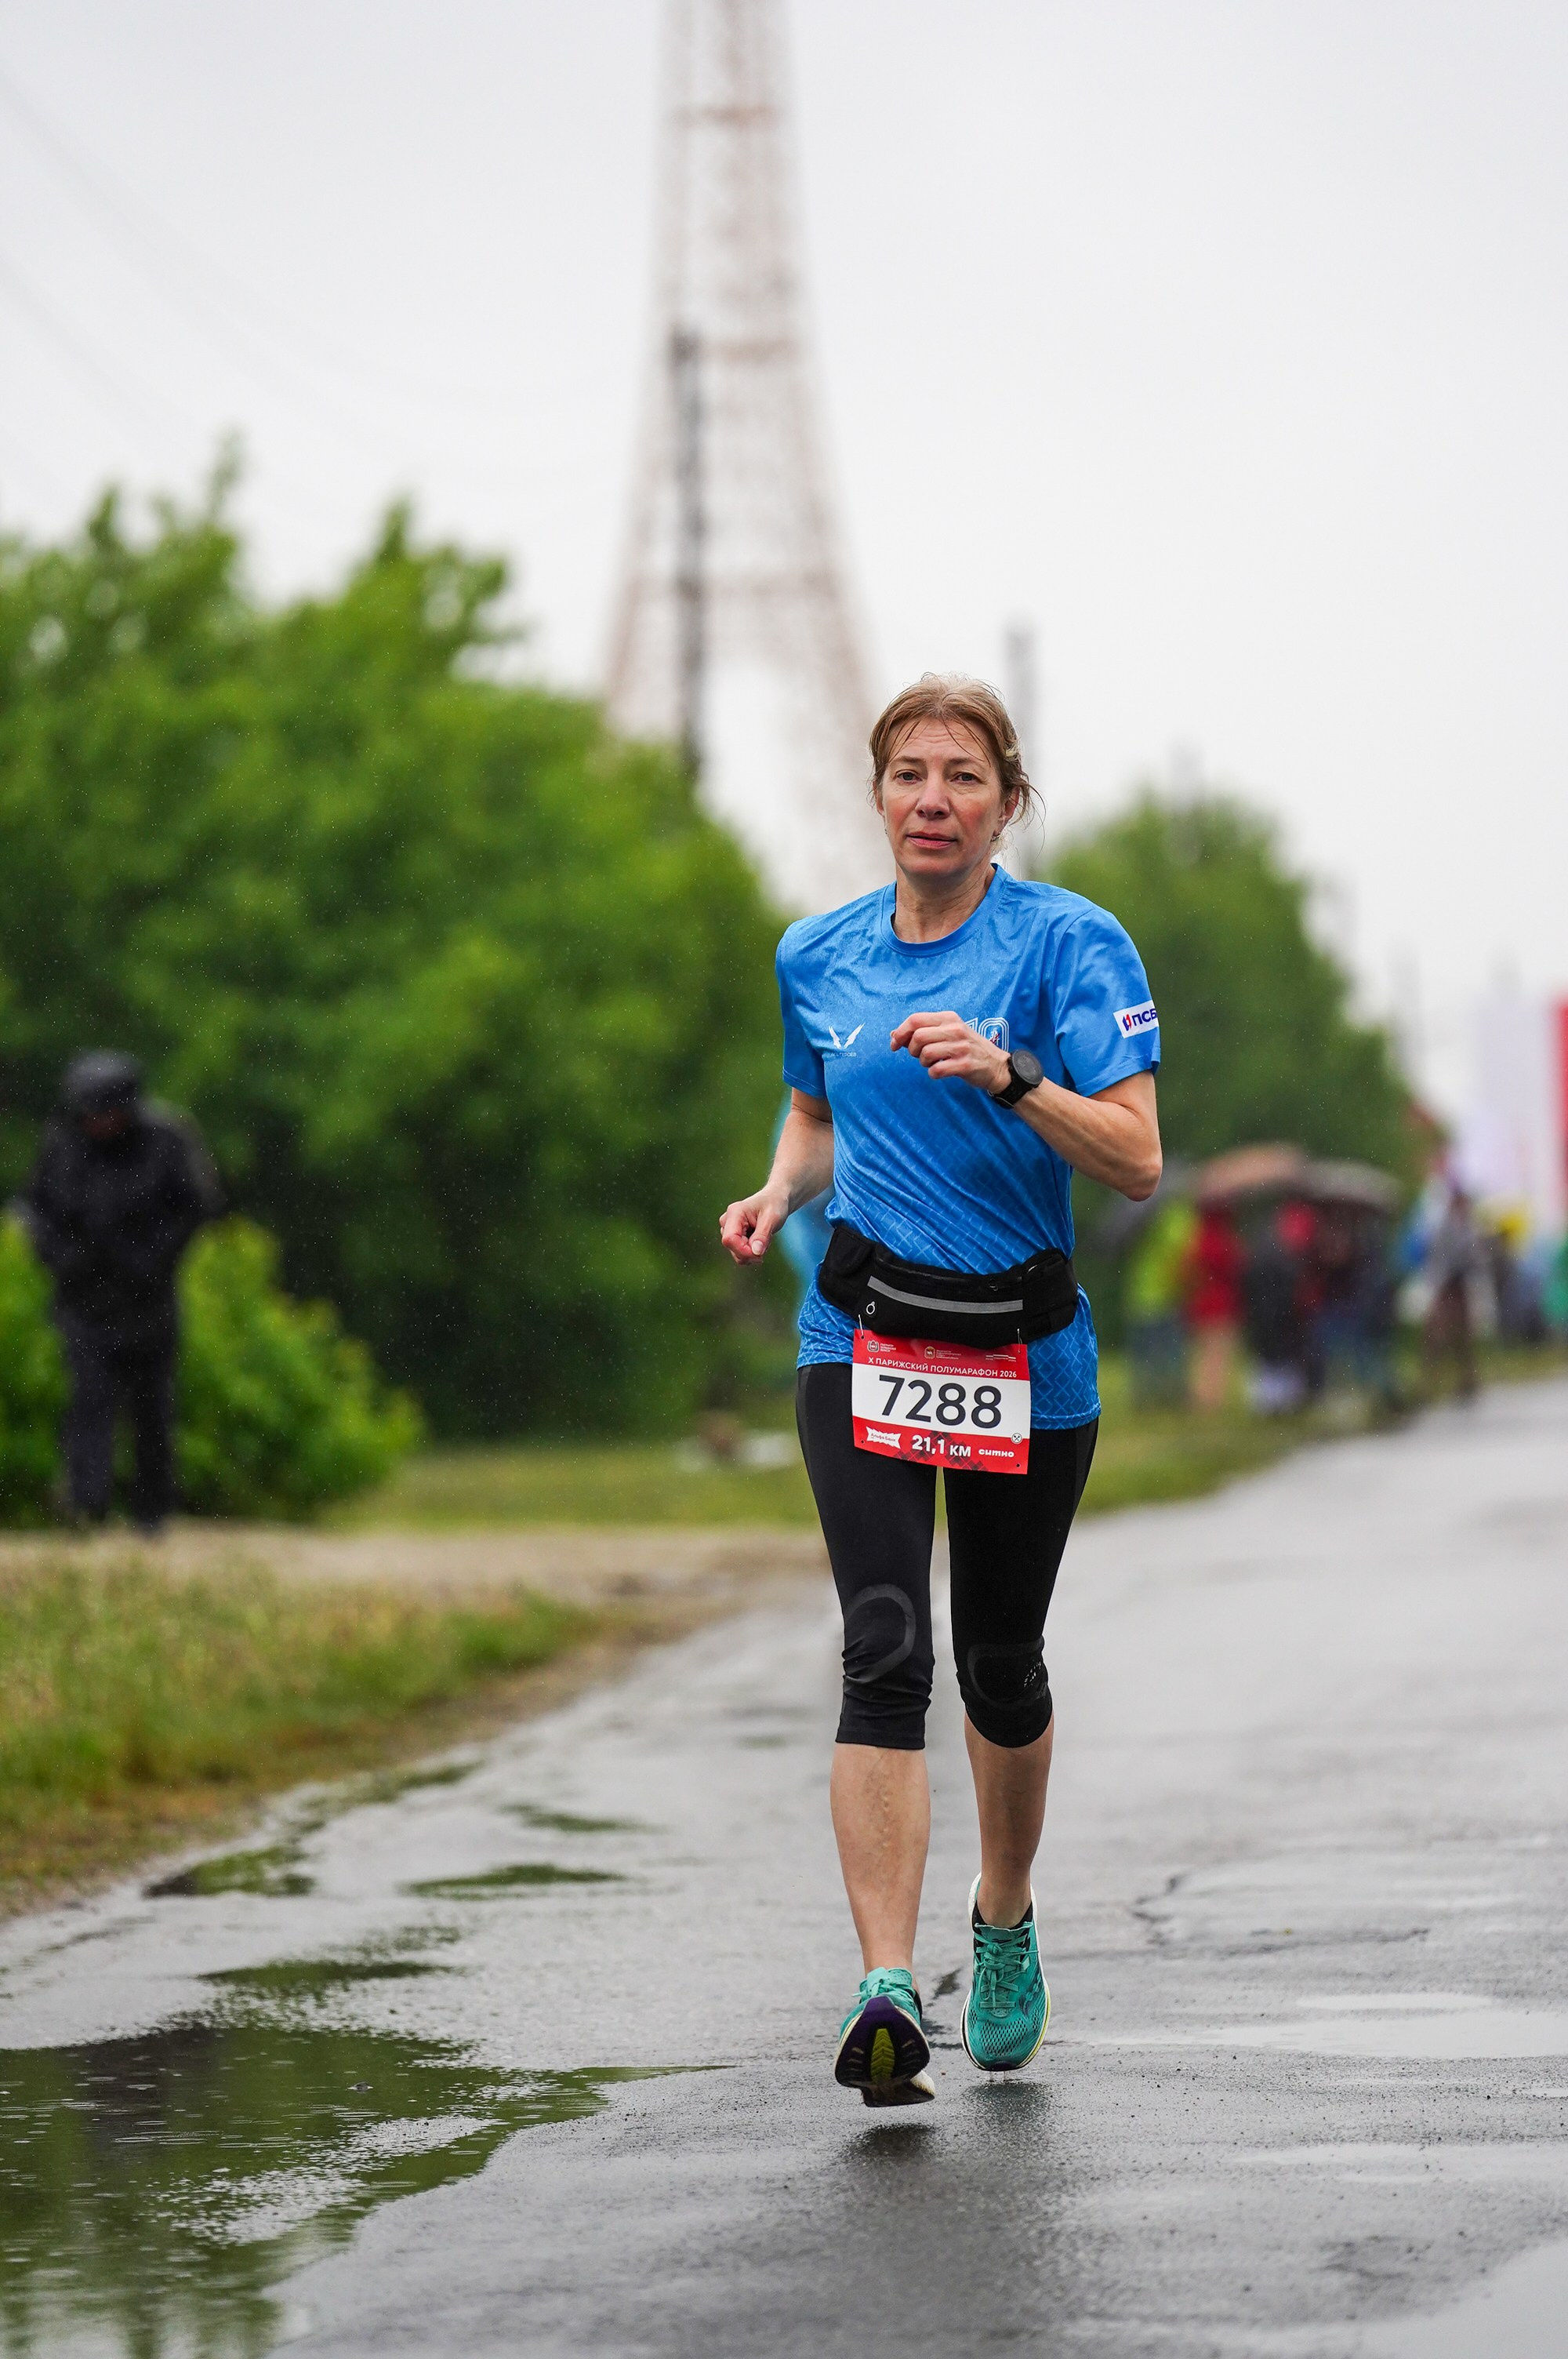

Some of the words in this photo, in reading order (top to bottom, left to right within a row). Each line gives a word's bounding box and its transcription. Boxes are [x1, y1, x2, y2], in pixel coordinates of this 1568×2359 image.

[1131, 1009, 1158, 1027] ПСБ
[876, 1358, 928, 1372] ПАРИЖСКИЙ
[931, 1363, 998, 1377] ПОЛУМАРАФОН
[879, 1374, 1002, 1429] 7288
[912, 1434, 945, 1455] 21,1
